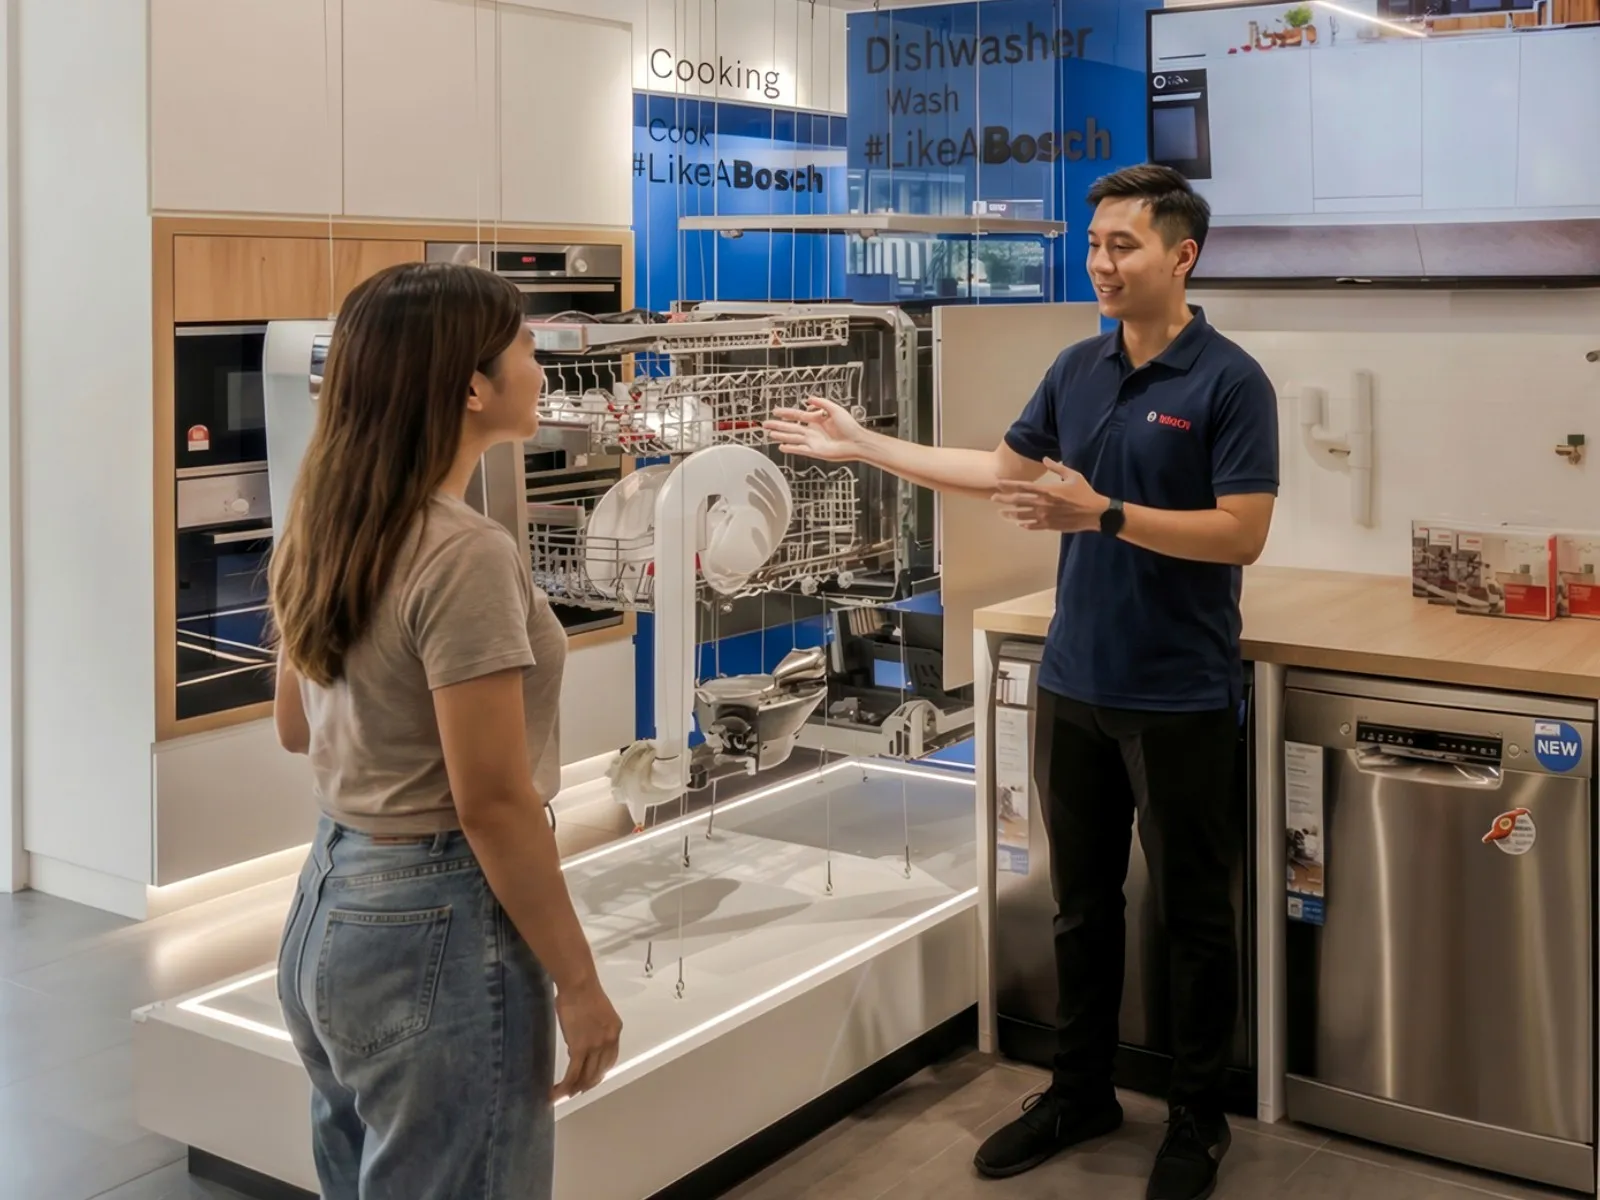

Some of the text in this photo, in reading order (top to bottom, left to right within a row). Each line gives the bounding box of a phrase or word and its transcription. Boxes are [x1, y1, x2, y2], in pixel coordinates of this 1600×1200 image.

[866, 21, 1093, 74] Dishwasher
[650, 48, 780, 99] Cooking
[886, 84, 959, 115] Wash
[648, 118, 710, 146] Cook
[863, 117, 1112, 168] #LikeABosch
[633, 152, 823, 193] #LikeABosch
[1537, 739, 1578, 757] NEW
